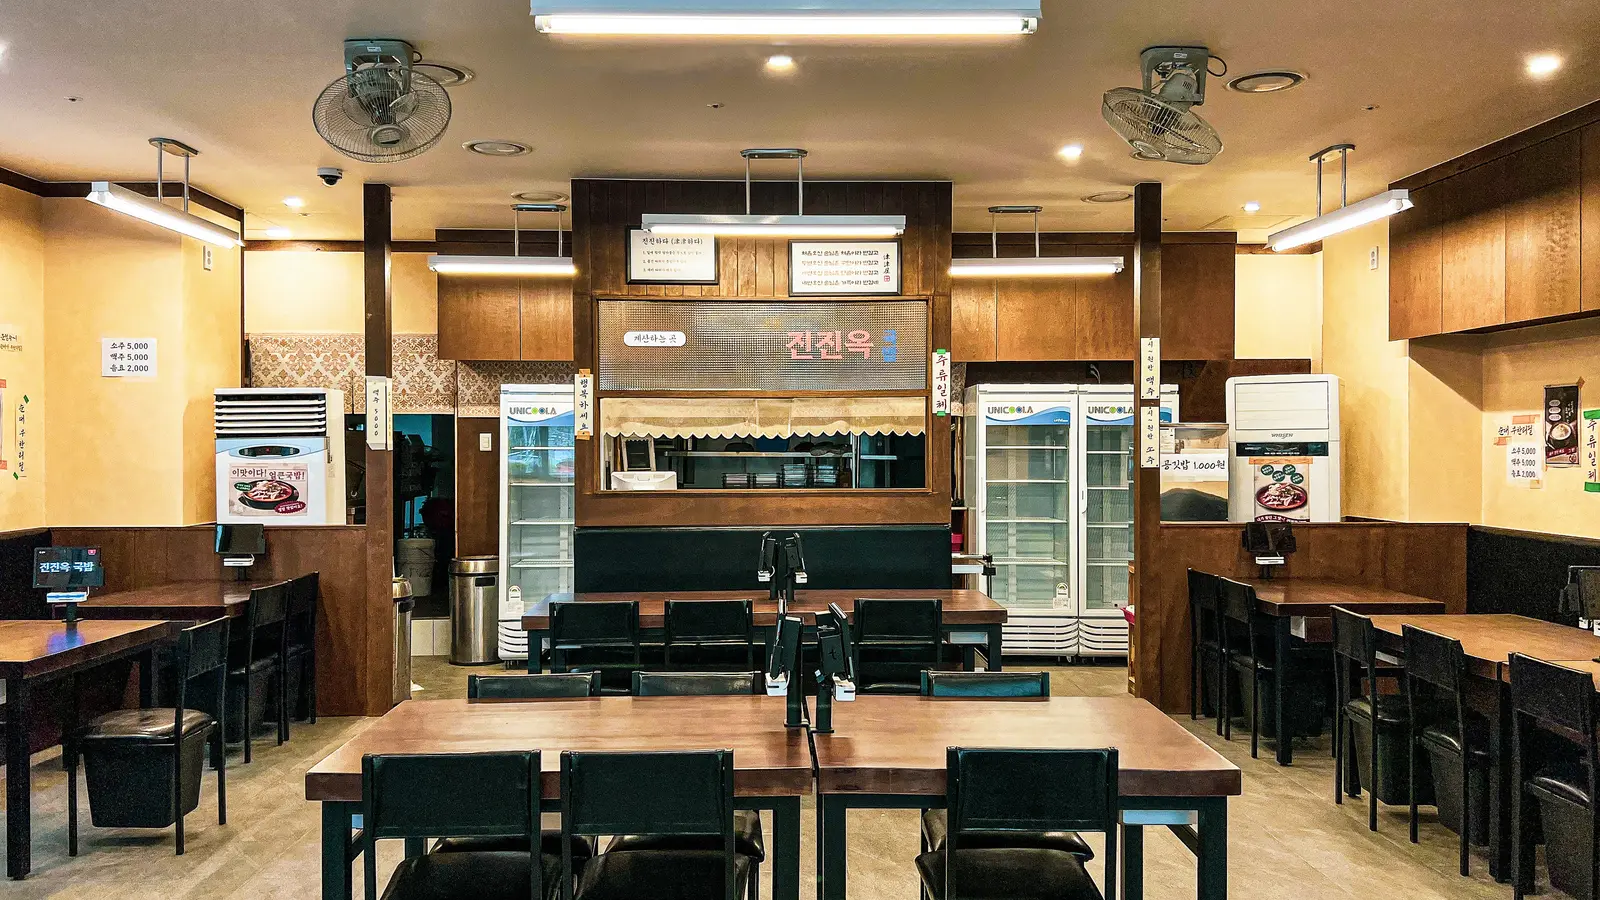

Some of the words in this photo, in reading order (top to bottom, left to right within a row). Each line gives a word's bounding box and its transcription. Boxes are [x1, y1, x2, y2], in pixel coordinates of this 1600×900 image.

[634, 334, 667, 343] 계산하는
[668, 334, 677, 343] 곳
[110, 342, 126, 350] 소주
[127, 342, 149, 351] 5,000
[786, 329, 874, 360] 진진옥
[110, 353, 126, 361] 맥주
[127, 353, 149, 362] 5,000
[110, 364, 126, 372] 음료
[127, 364, 149, 373] 2,000
[936, 355, 949, 411] 주류일체
[579, 379, 589, 431] 행복하세요
[1586, 419, 1597, 482] 주류일체
[1161, 460, 1191, 471] 공깃밥
[232, 468, 267, 478] 이맛이다!
[40, 561, 71, 573] 진진옥
[73, 561, 94, 573] 국밥
